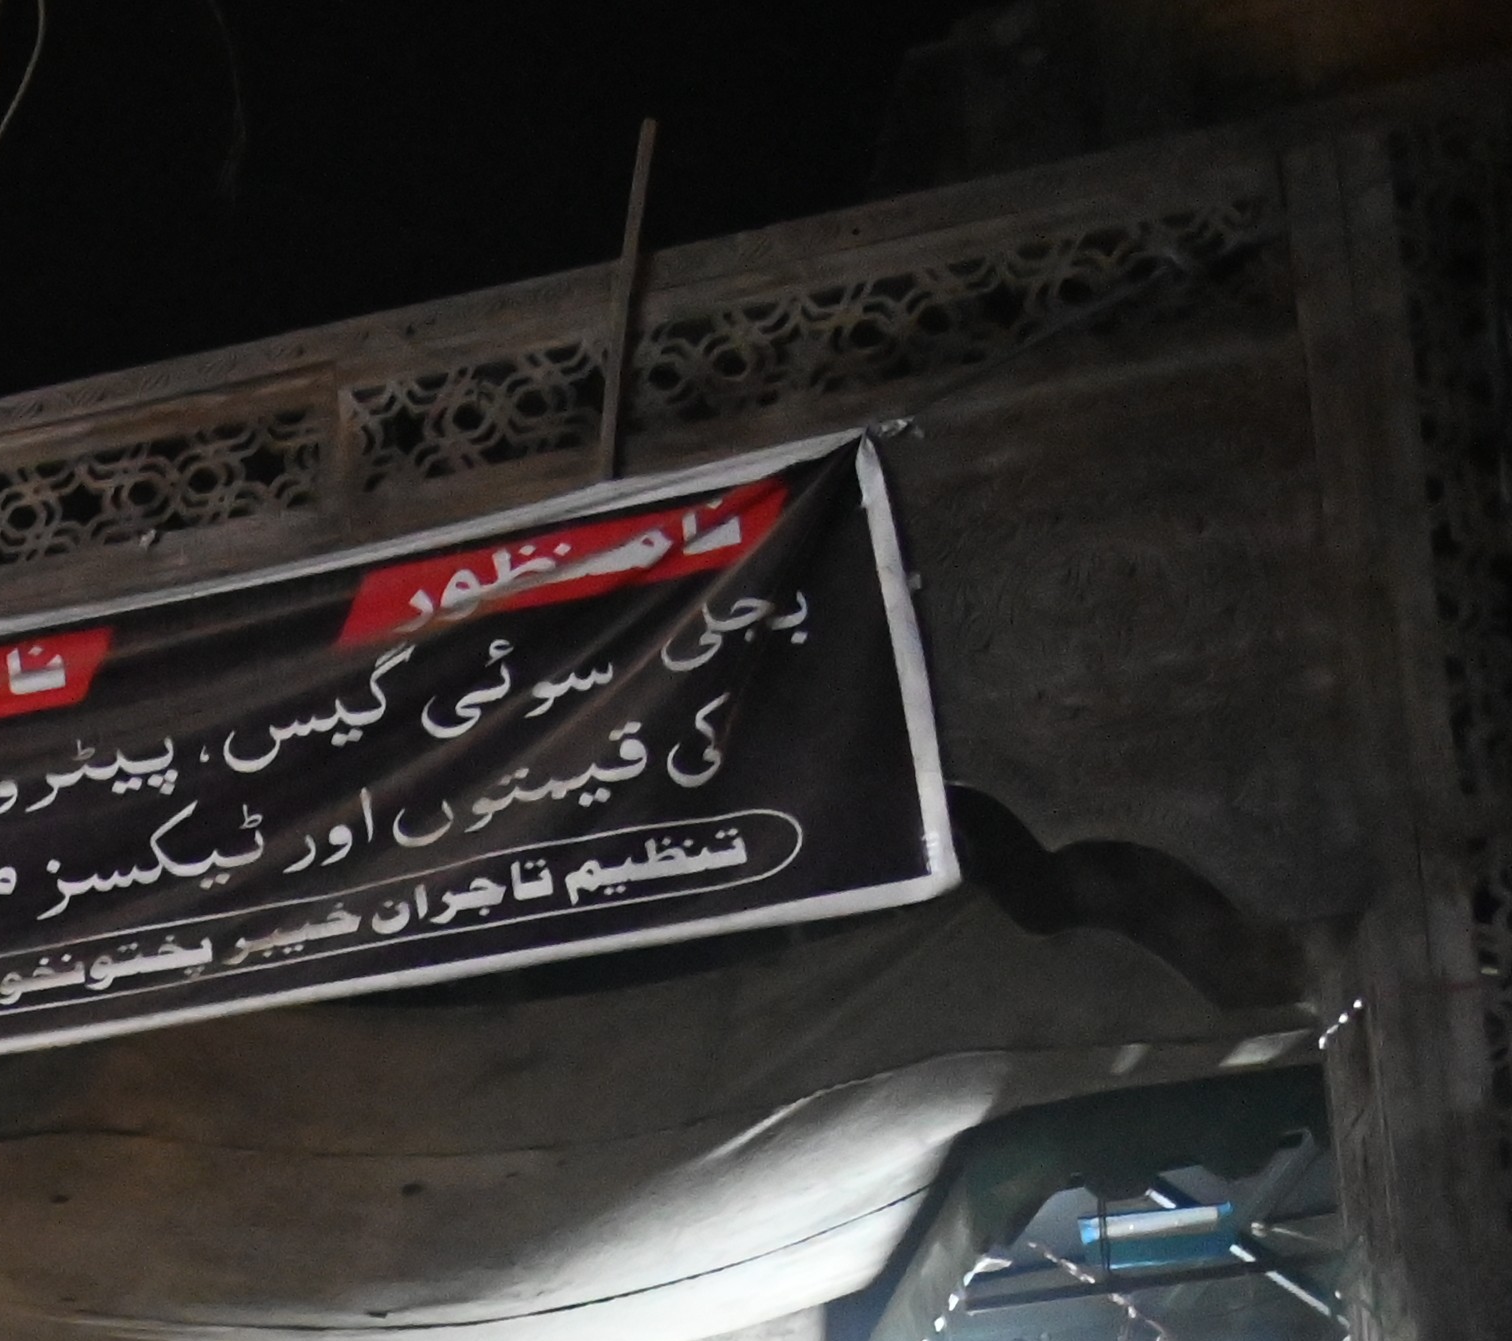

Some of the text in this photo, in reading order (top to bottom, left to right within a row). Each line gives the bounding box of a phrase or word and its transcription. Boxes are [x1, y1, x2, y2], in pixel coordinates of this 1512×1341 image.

[392, 500, 743, 634] نامنظور
[662, 590, 810, 673] بجلی
[421, 638, 614, 738] سوئی
[392, 719, 649, 848] قیمتوں
[667, 691, 731, 788] کی
[37, 800, 265, 920] ٹیکسز
[283, 788, 375, 874] اور
[564, 827, 749, 906] تنظیم
[370, 856, 555, 936] تاجران
